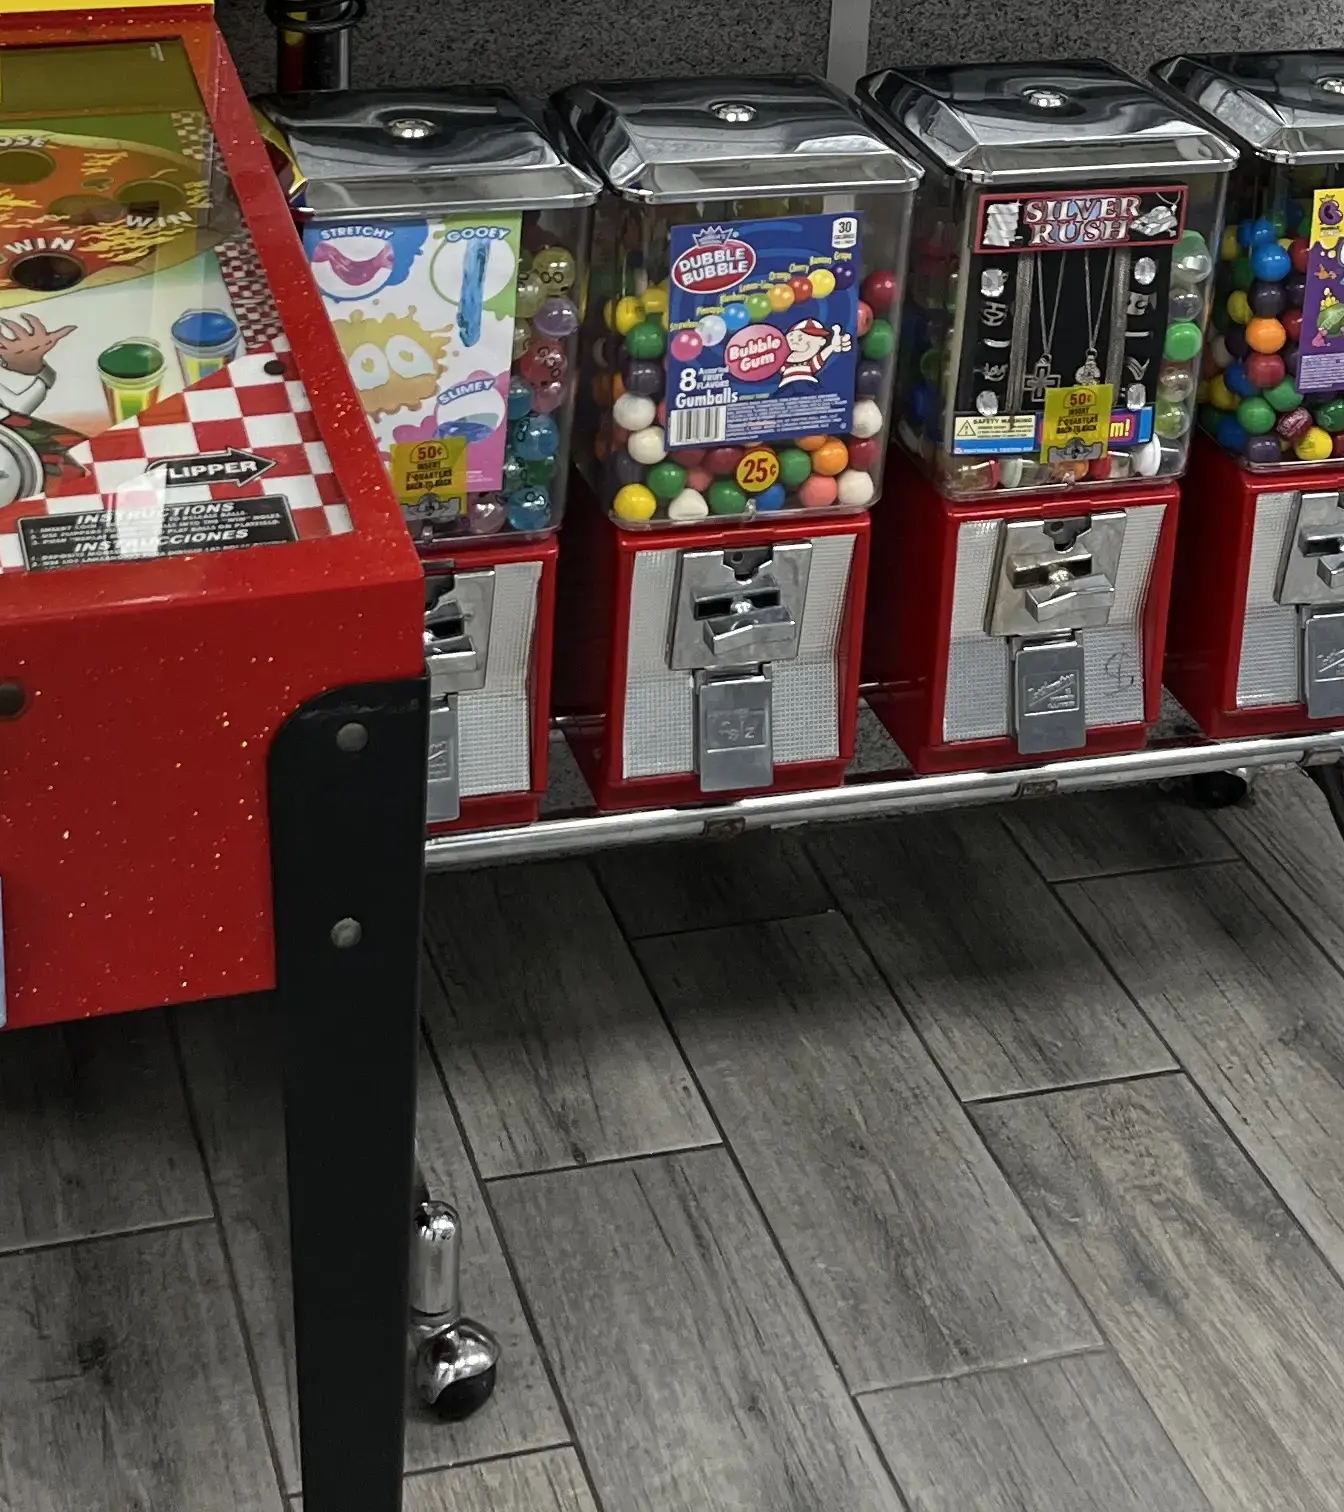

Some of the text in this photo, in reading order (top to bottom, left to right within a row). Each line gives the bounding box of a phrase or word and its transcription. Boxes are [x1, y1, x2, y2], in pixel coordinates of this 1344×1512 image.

[126, 211, 193, 228] WIN
[1023, 195, 1142, 224] SILVER
[320, 225, 510, 242] STRETCHY GOOEY
[838, 220, 852, 234] 30
[1030, 219, 1131, 246] RUSH
[6, 237, 76, 255] WIN
[678, 247, 746, 272] DUBBLE
[682, 260, 749, 286] BUBBLE
[729, 336, 782, 360] Bubble
[740, 352, 775, 372] Gum
[679, 367, 697, 391] 8
[697, 379, 730, 390] FLAVORS
[703, 373, 724, 381] FRUIT
[437, 379, 496, 405] SLIMEY
[675, 387, 739, 408] Gumballs
[1069, 393, 1092, 406] 50¢
[417, 445, 444, 460] 50¢
[167, 460, 258, 480] LIPPER
[742, 456, 778, 484] 25¢
[76, 501, 236, 526] INSTRUCTIONS
[74, 528, 250, 554] INSTRUCCIONES
